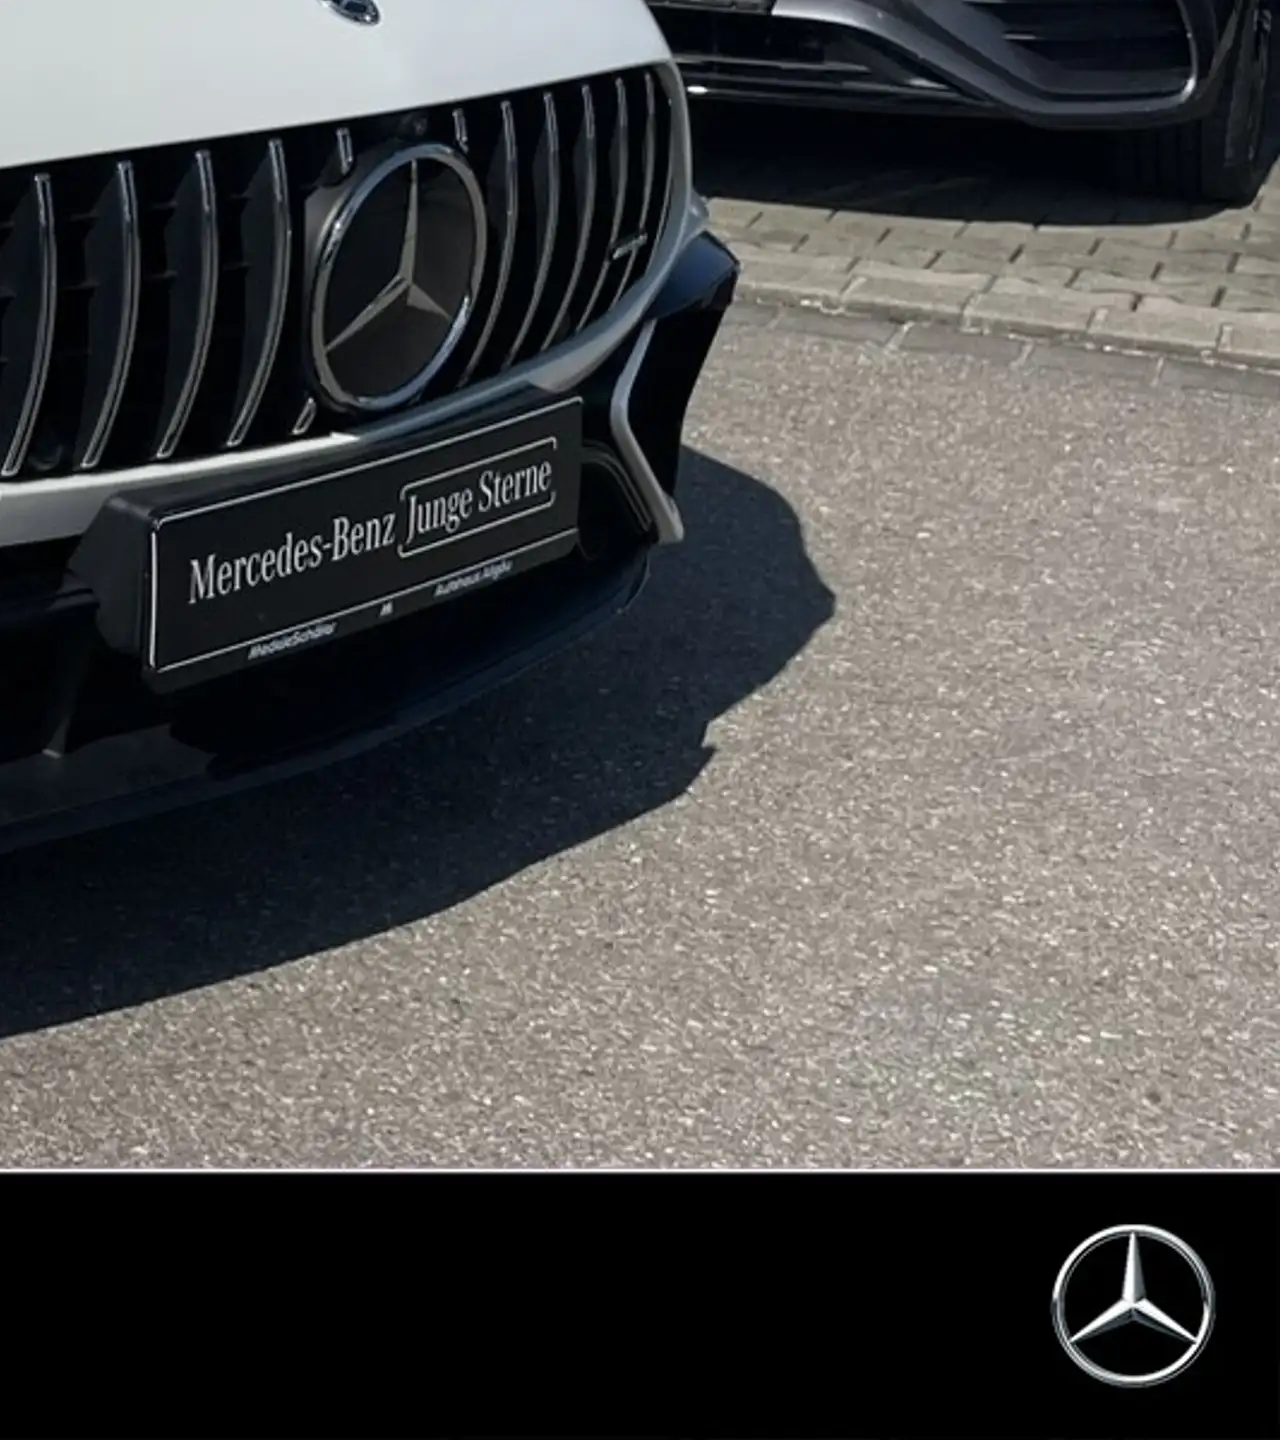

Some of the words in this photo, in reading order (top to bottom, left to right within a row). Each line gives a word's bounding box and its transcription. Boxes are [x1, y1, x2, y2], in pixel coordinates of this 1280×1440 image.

[188, 512, 397, 605] Mercedes-Benz
[404, 487, 474, 545] Junge
[477, 459, 553, 513] Sterne
